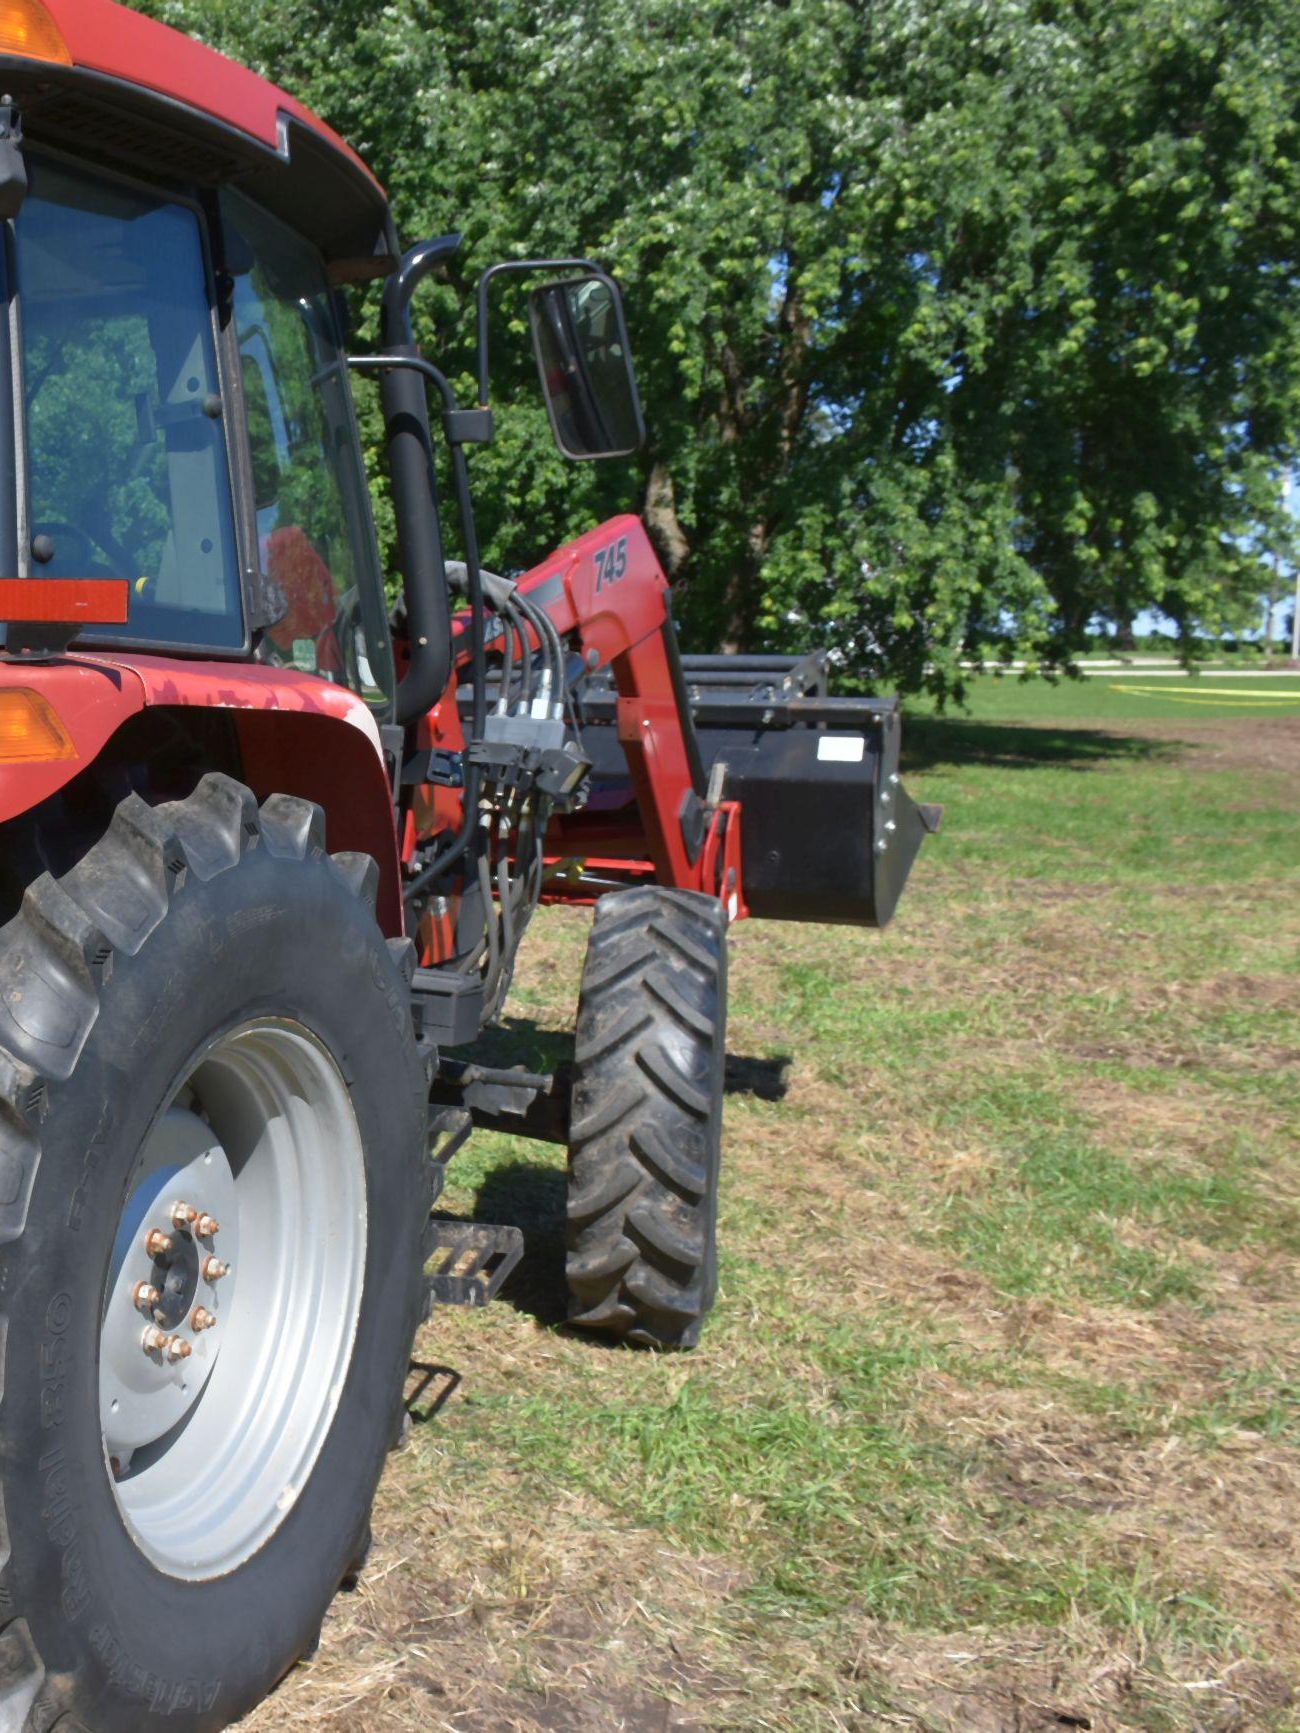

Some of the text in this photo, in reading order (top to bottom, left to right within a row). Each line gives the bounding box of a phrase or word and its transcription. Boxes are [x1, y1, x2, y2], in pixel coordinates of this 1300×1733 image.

[593, 537, 628, 593] 745
[39, 1291, 73, 1433] 850
[38, 1447, 93, 1622] Radial
